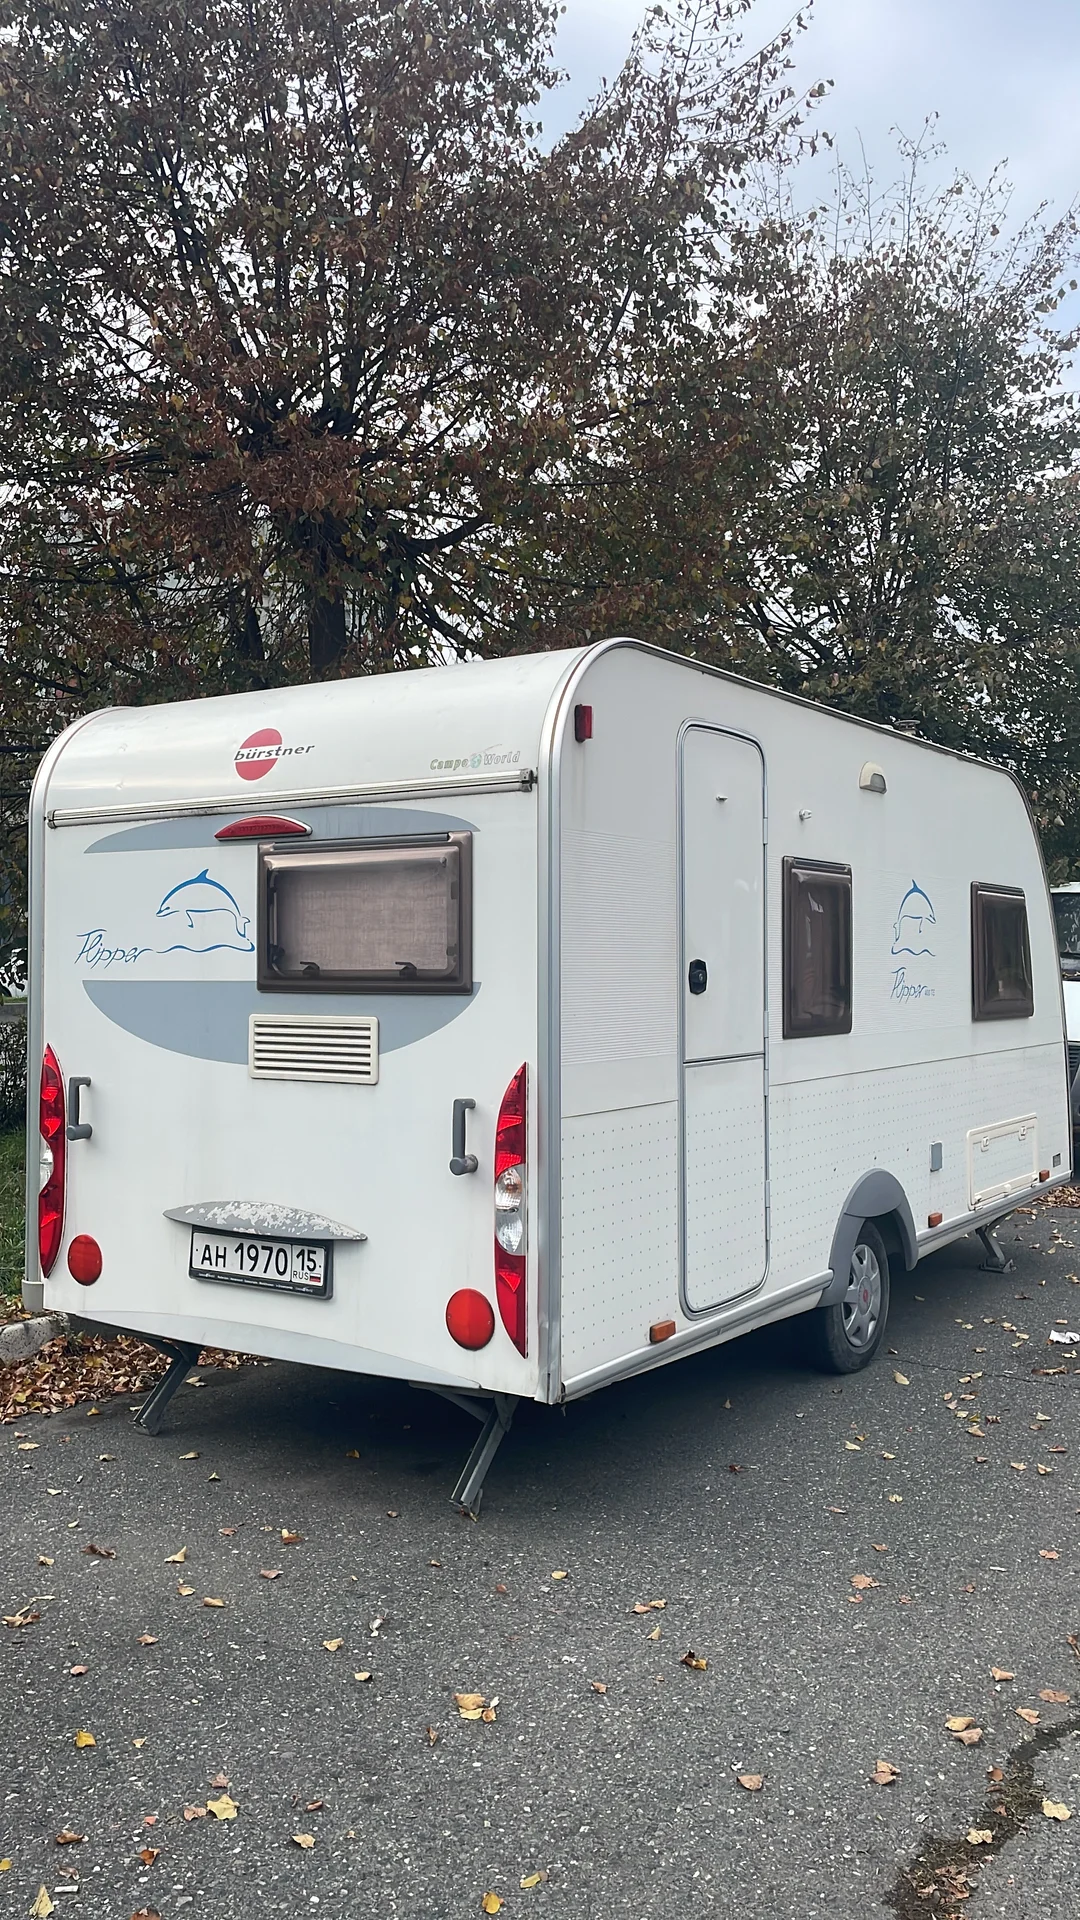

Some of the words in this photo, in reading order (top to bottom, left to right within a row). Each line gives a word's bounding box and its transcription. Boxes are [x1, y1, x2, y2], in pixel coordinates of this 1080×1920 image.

[234, 744, 315, 761] bürstner
[483, 750, 521, 766] World
[74, 928, 153, 969] Flipper
[234, 1242, 288, 1276] 1970
[296, 1248, 317, 1272] 15
[292, 1270, 309, 1281] RUS
